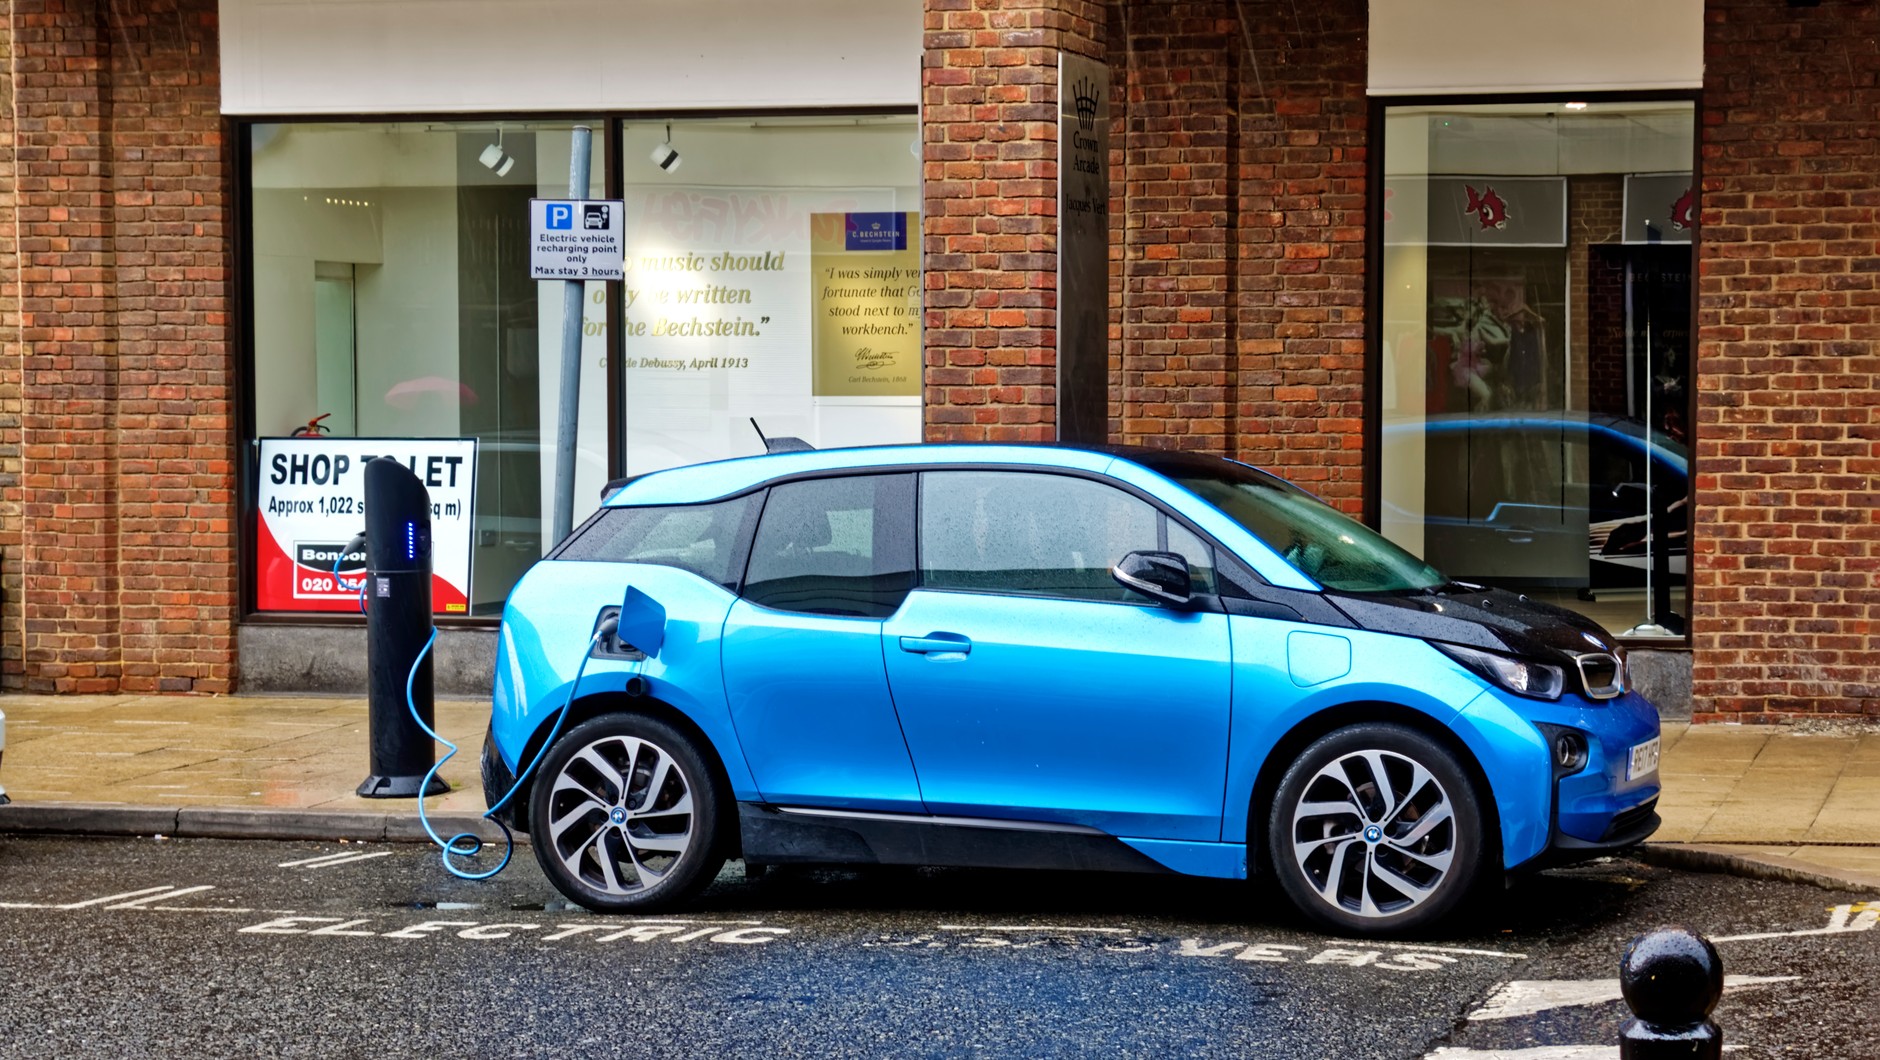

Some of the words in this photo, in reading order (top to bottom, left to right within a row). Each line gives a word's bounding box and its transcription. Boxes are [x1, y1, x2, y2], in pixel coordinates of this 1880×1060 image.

[1073, 131, 1098, 153] Crown
[1073, 153, 1100, 175] Arcade
[1066, 193, 1091, 217] Jacques
[1092, 197, 1106, 216] Vert
[540, 234, 577, 242] Electric
[580, 235, 615, 243] vehicle
[537, 244, 589, 254] recharging
[592, 245, 617, 253] point
[566, 255, 587, 263] only
[641, 252, 704, 272] music
[710, 251, 785, 271] should
[535, 266, 555, 275] Max
[558, 267, 578, 276] stay
[582, 267, 588, 275] 3
[592, 268, 620, 276] hours
[838, 270, 860, 279] was
[863, 267, 902, 281] simply
[677, 284, 751, 304] written
[822, 286, 877, 300] fortunate
[880, 286, 904, 297] that
[829, 305, 860, 316] stood
[864, 306, 889, 316] next
[893, 306, 904, 316] to
[908, 307, 921, 319] m
[639, 357, 686, 371] Debussy,
[689, 357, 718, 369] April
[721, 357, 749, 368] 1913
[270, 453, 350, 485] SHOP
[268, 496, 314, 517] Approx
[318, 496, 353, 517] 1,022
[445, 499, 461, 521] m)
[302, 578, 333, 592] 020
[238, 917, 791, 944] ELECTRIC
